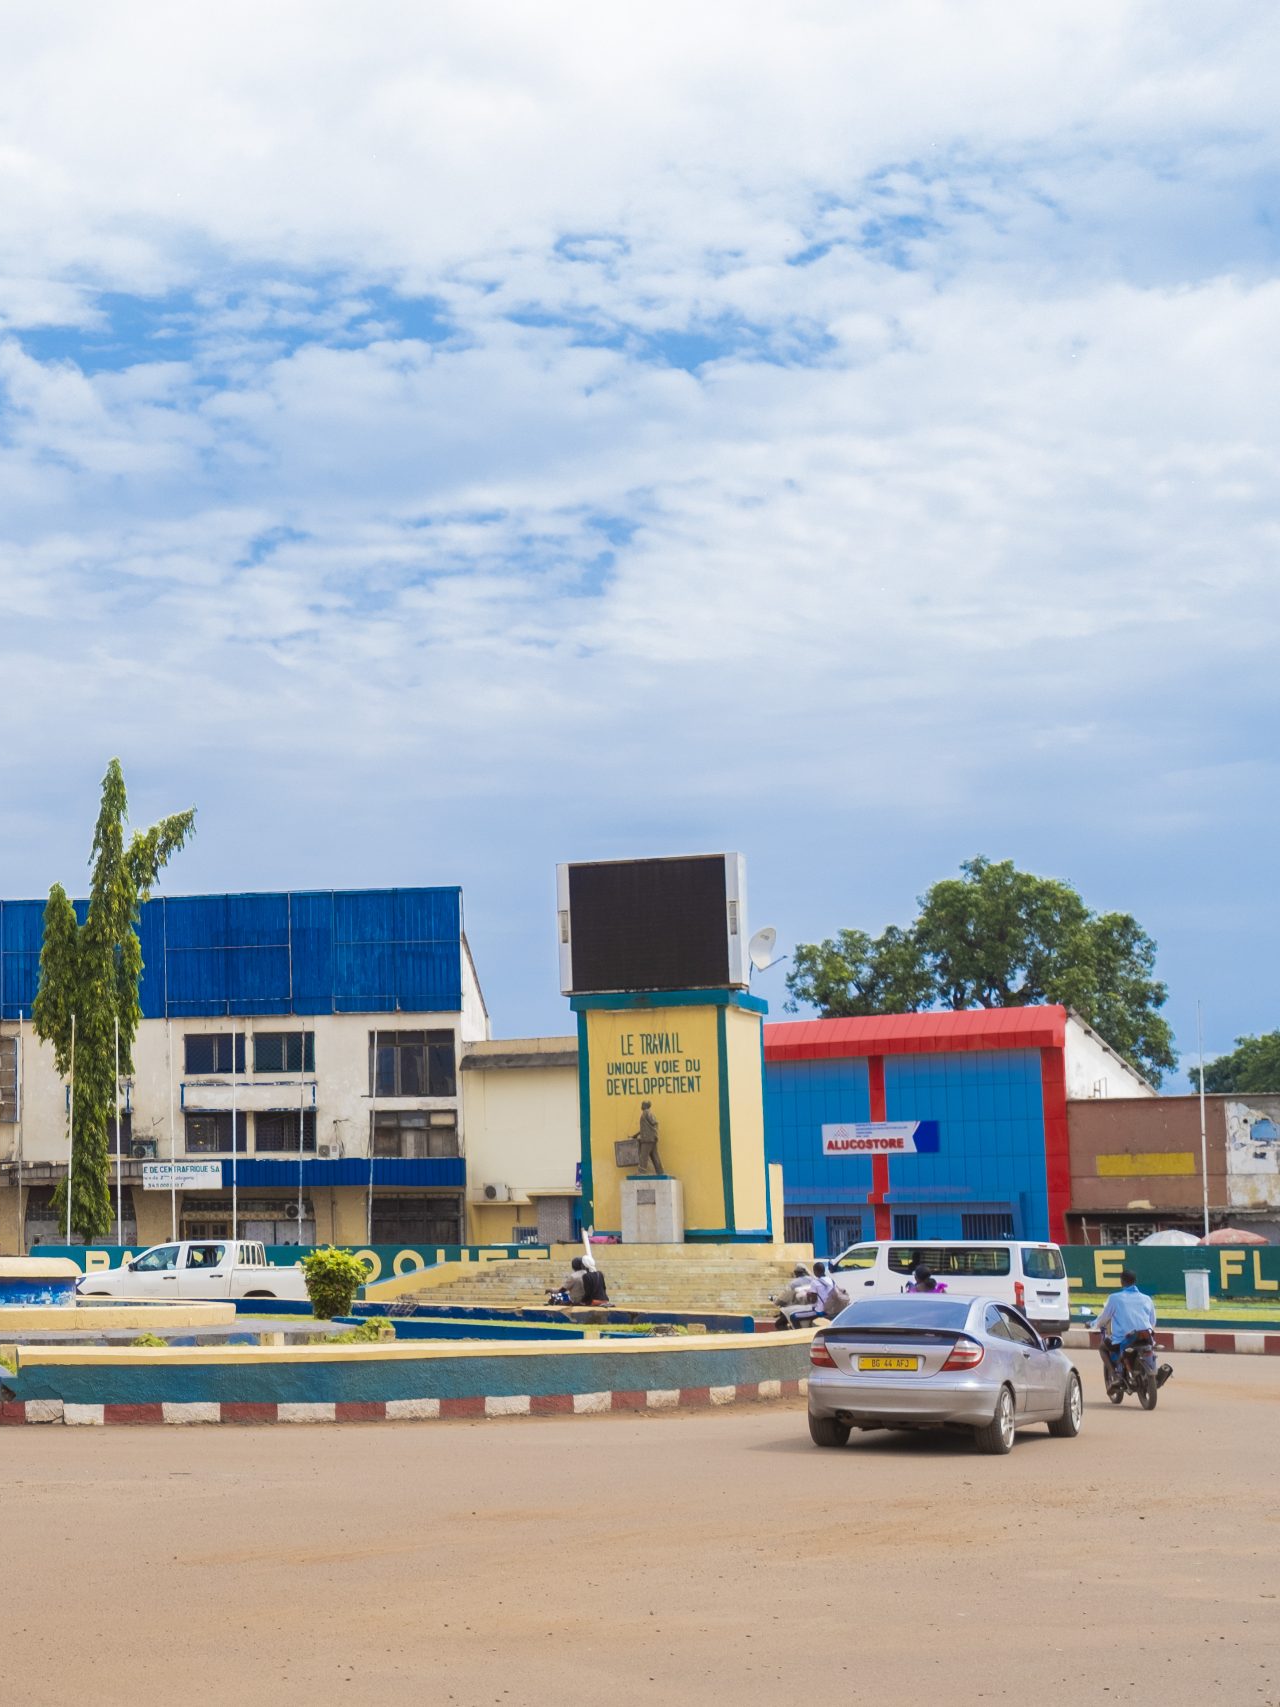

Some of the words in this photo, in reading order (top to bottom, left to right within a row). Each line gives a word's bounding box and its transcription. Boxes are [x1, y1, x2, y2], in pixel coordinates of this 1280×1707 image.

[621, 1034, 634, 1056] LE
[639, 1032, 684, 1055] TRAVAIL
[607, 1061, 648, 1075] UNIQUE
[654, 1060, 680, 1074] VOIE
[685, 1059, 701, 1073] DU
[607, 1076, 701, 1096] DEVELOPPEMENT
[827, 1138, 905, 1151] ALUCOSTORE
[160, 1165, 208, 1173] CENTRAFRIQUE
[211, 1165, 220, 1173] SA
[883, 1359, 893, 1367] 44
